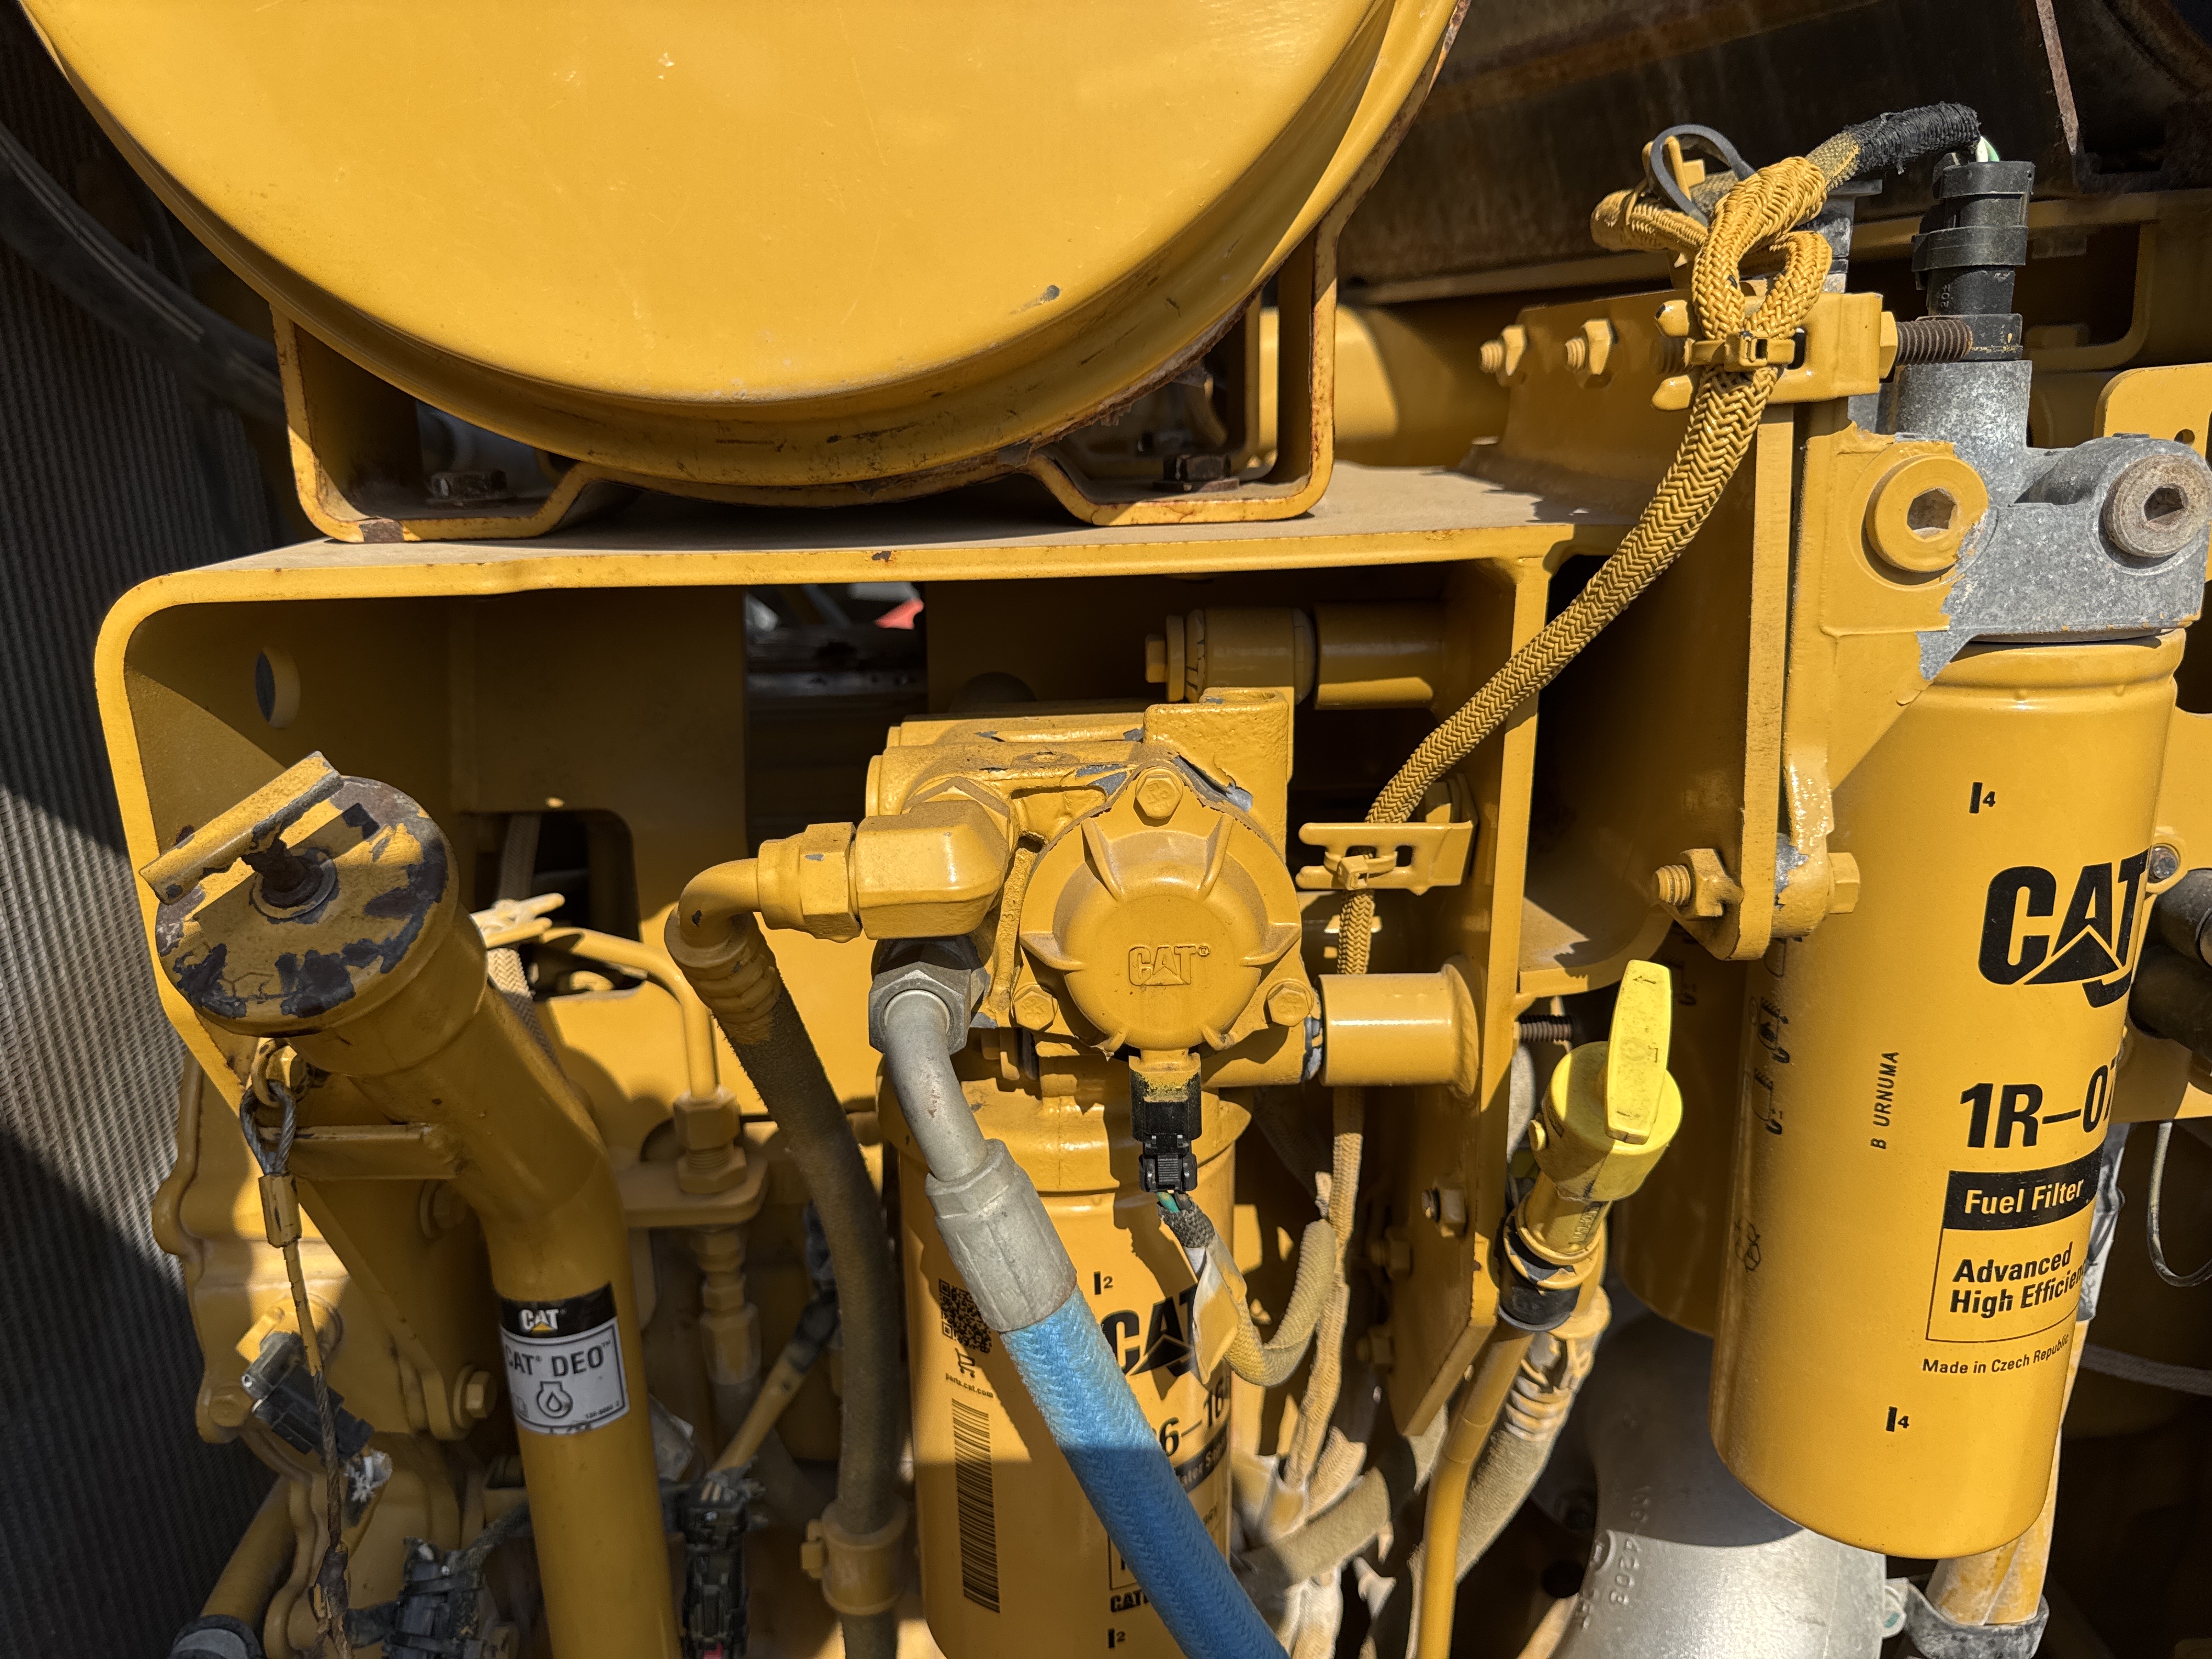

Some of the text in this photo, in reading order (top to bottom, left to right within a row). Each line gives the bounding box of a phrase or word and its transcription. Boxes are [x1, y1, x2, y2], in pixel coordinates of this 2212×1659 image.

[1978, 847, 2152, 985] CAT
[1965, 1179, 2084, 1215] Fuel Filter
[1952, 1241, 2073, 1283] Advanced
[1950, 1288, 2013, 1319] High
[1922, 1334, 2069, 1374] Made in Czech Republic
